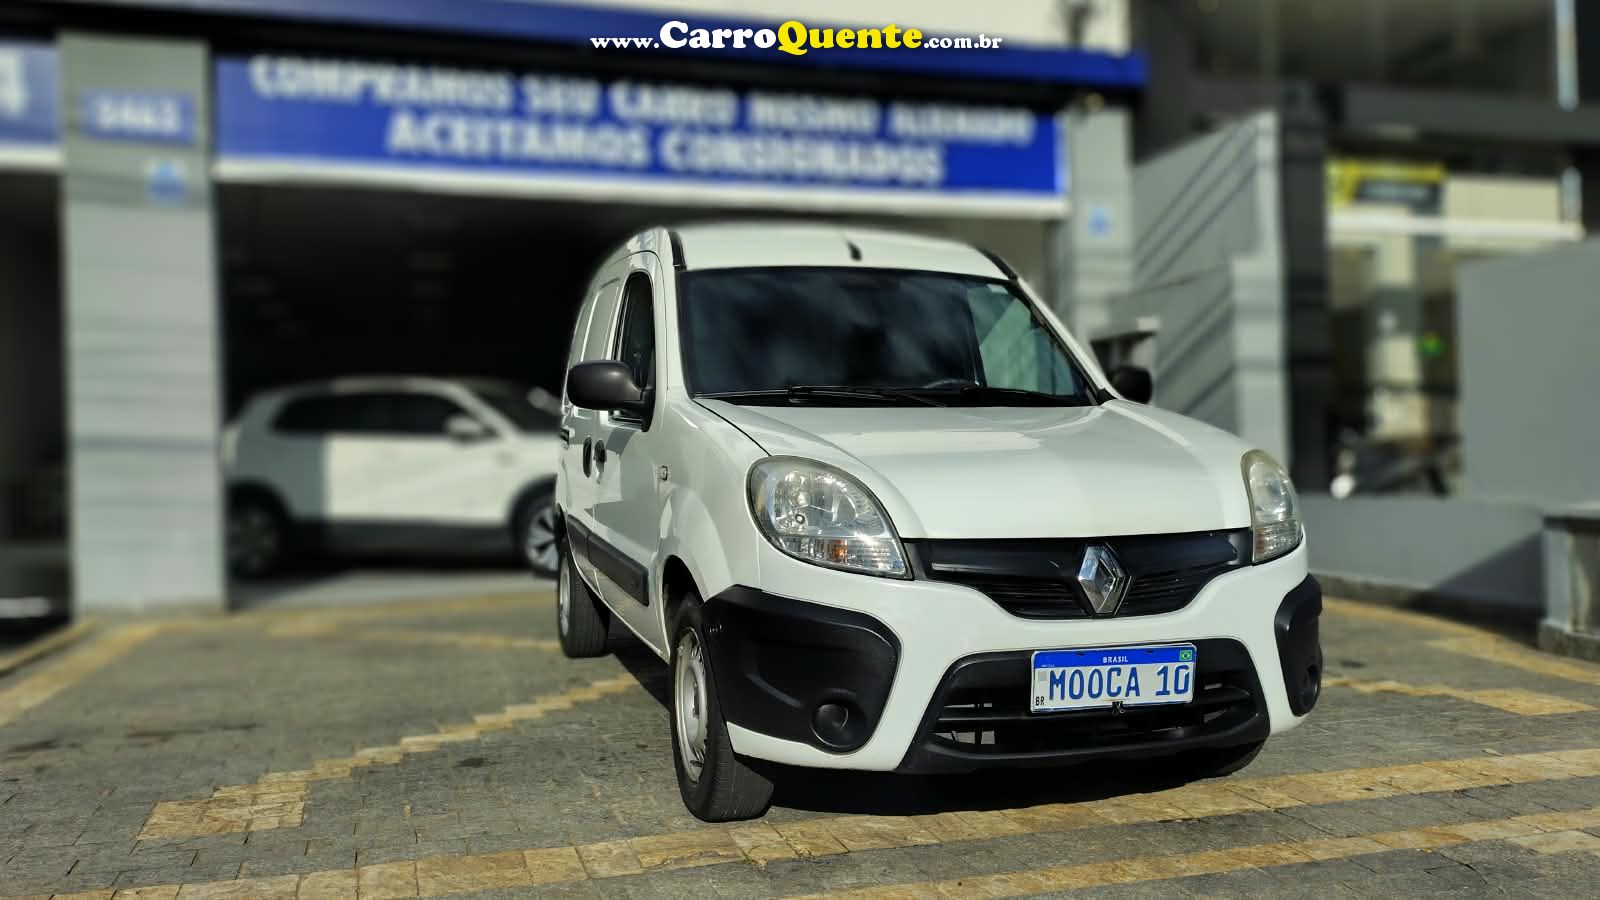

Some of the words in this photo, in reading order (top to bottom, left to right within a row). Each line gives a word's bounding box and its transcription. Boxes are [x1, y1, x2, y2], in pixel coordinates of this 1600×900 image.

[250, 55, 513, 111] COMPRAMOS
[523, 74, 600, 118] SEU
[387, 109, 650, 168] ACEITAMOS
[1103, 655, 1128, 663] BRASIL
[1049, 667, 1140, 700] MOOCA
